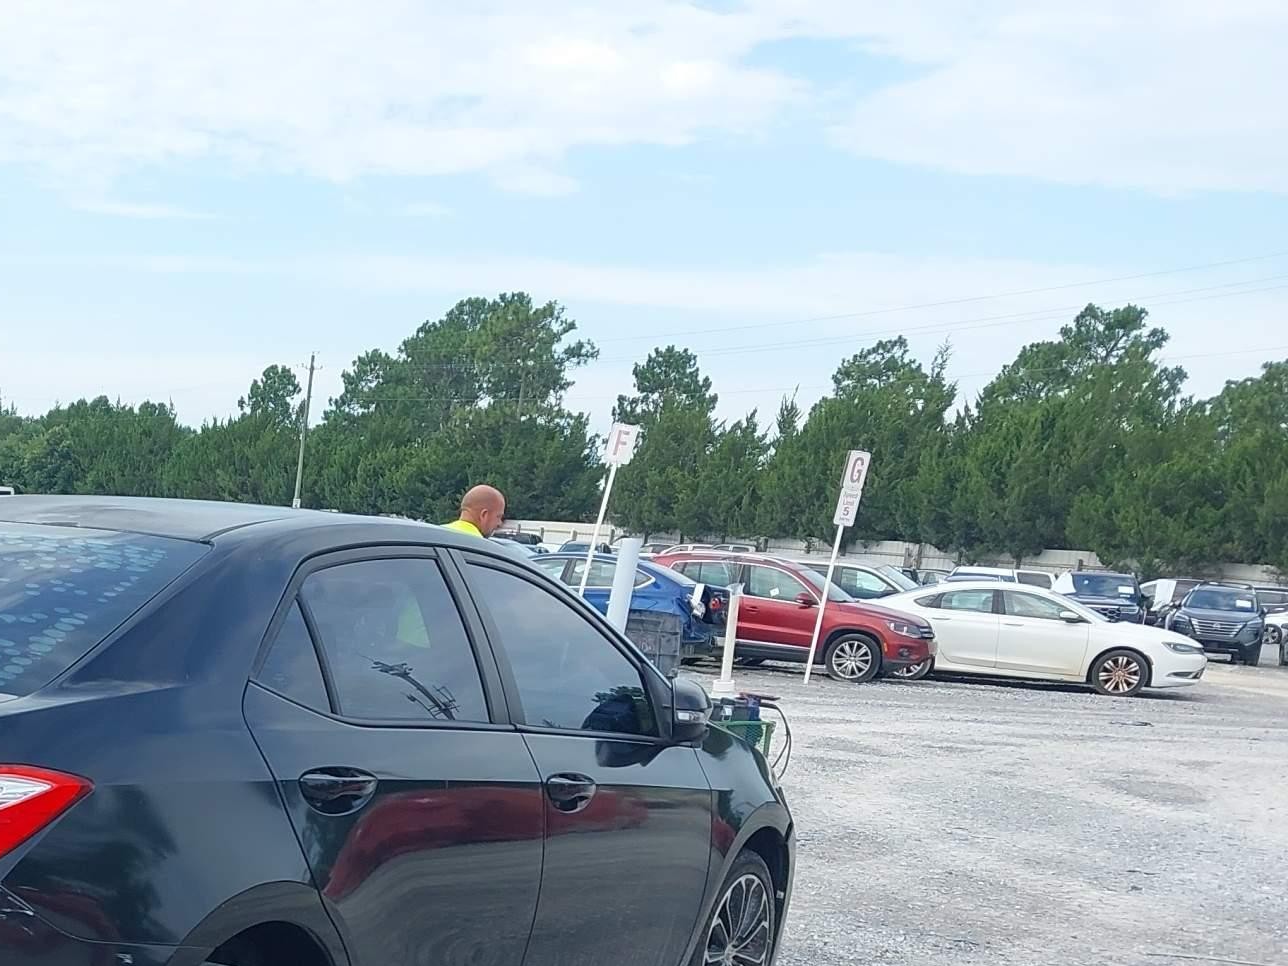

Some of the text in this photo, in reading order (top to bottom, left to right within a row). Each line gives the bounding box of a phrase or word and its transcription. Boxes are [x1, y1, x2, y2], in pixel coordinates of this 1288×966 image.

[613, 429, 630, 456] F
[850, 456, 865, 484] G
[842, 506, 850, 517] 5
